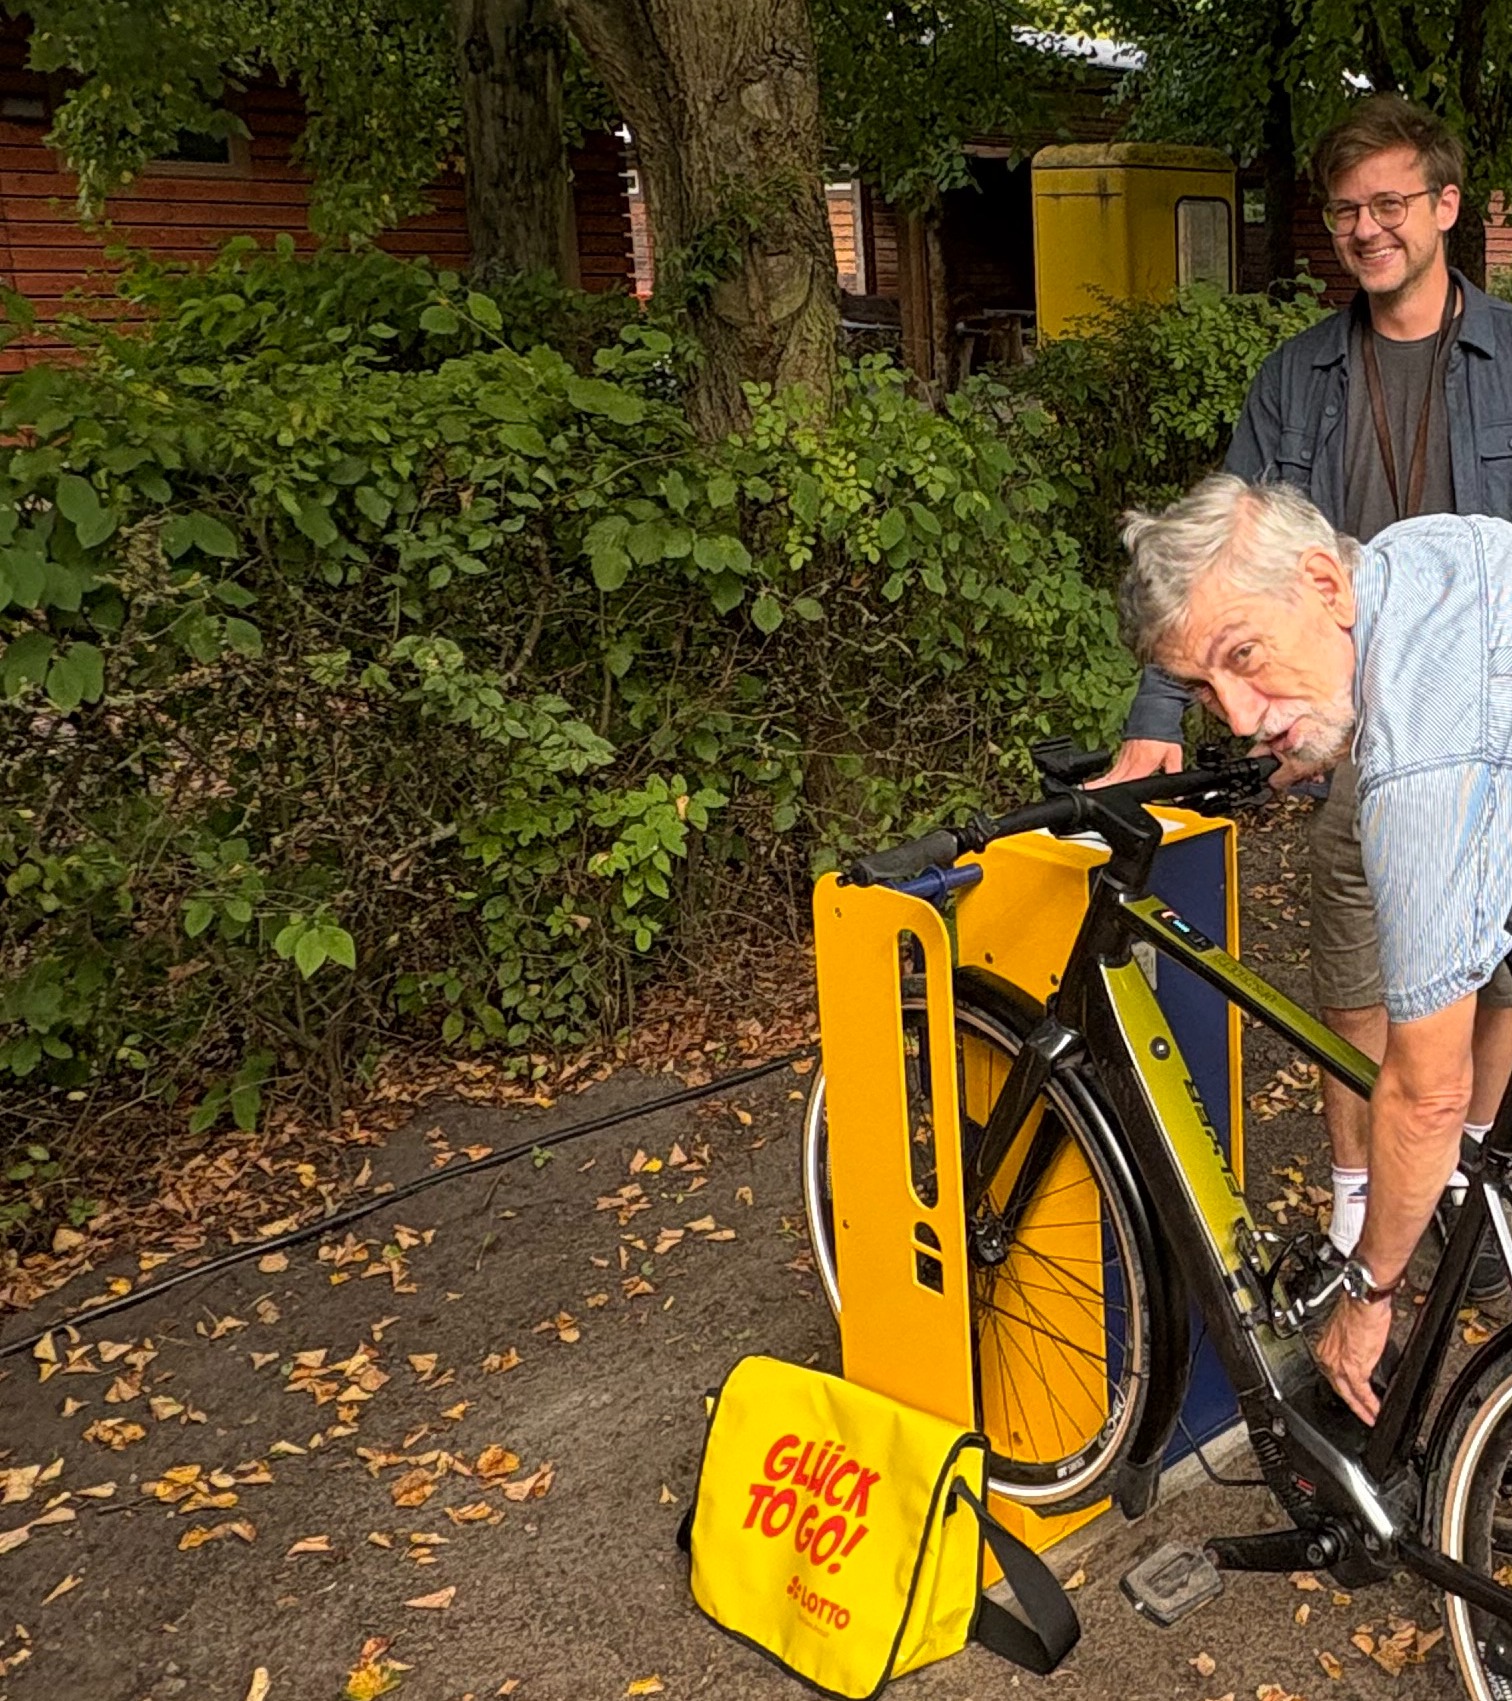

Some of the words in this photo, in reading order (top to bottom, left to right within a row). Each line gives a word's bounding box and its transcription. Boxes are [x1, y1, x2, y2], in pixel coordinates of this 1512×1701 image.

[763, 1434, 881, 1518] GLÜCK
[742, 1483, 798, 1538] TO
[794, 1504, 869, 1574] GO!
[800, 1585, 851, 1630] LOTTO
